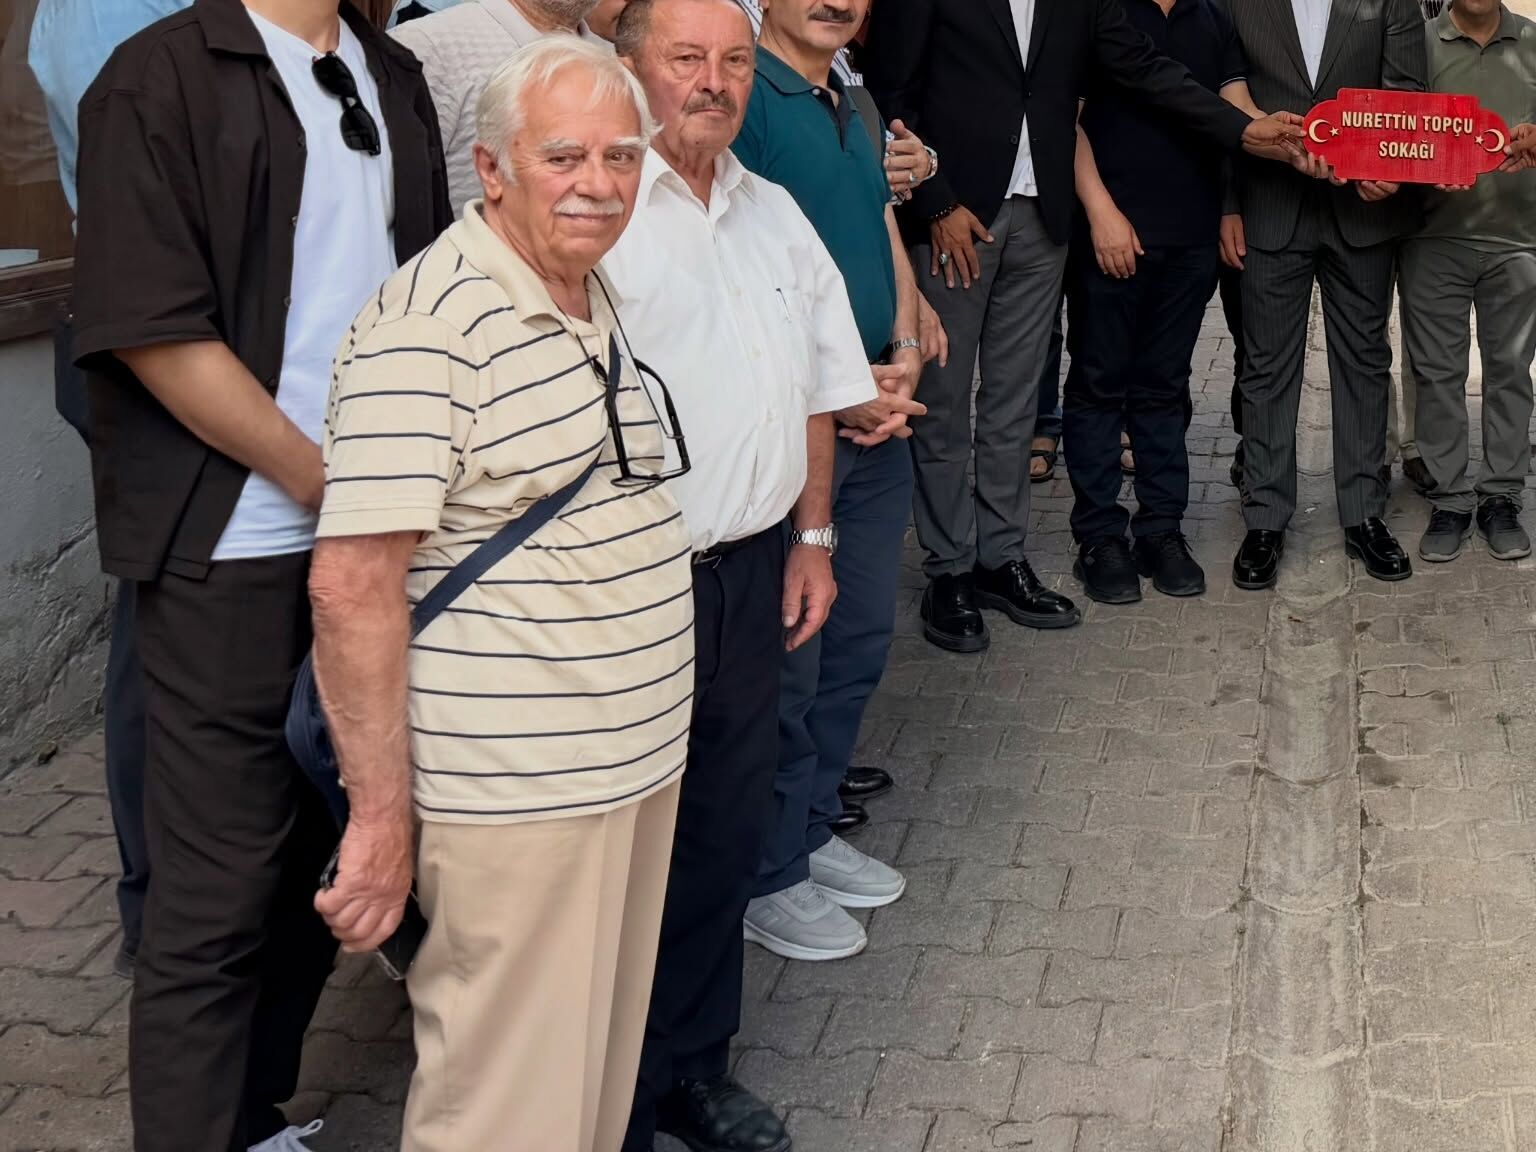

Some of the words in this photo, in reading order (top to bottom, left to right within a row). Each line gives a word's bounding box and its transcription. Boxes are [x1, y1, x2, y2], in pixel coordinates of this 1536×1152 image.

[1342, 110, 1417, 131] NURETTİN
[1423, 115, 1473, 137] TOPÇU
[1379, 139, 1434, 159] SOKAĞI
